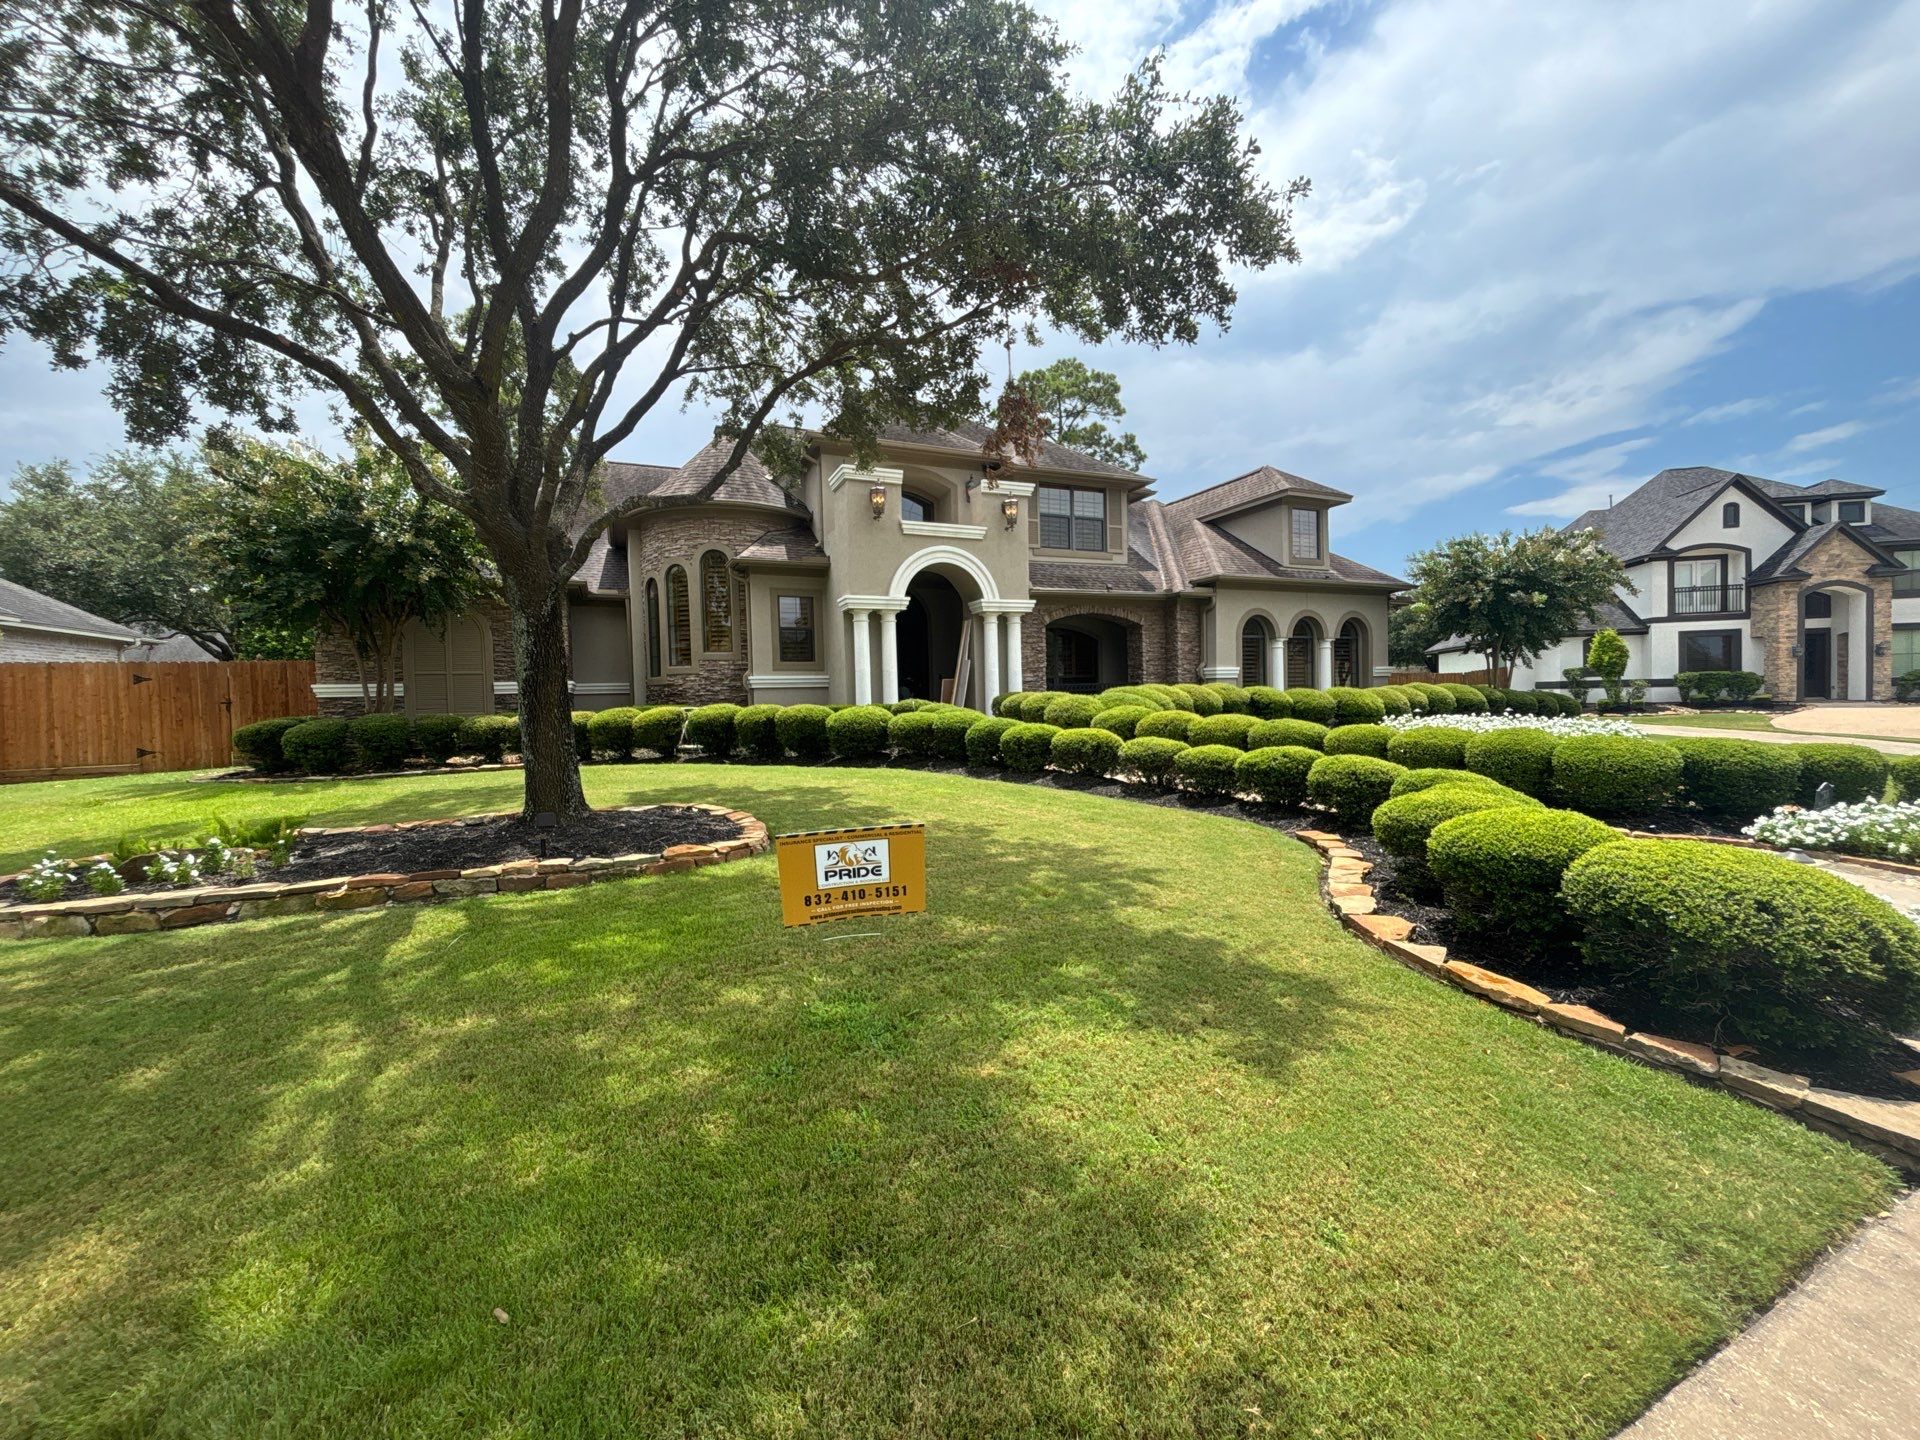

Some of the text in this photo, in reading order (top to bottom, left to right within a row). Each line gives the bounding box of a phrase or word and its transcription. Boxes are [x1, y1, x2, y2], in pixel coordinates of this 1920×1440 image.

[780, 838, 811, 846] INSURANCE
[824, 865, 882, 881] PRIDE
[804, 886, 907, 906] 832-410-5151
